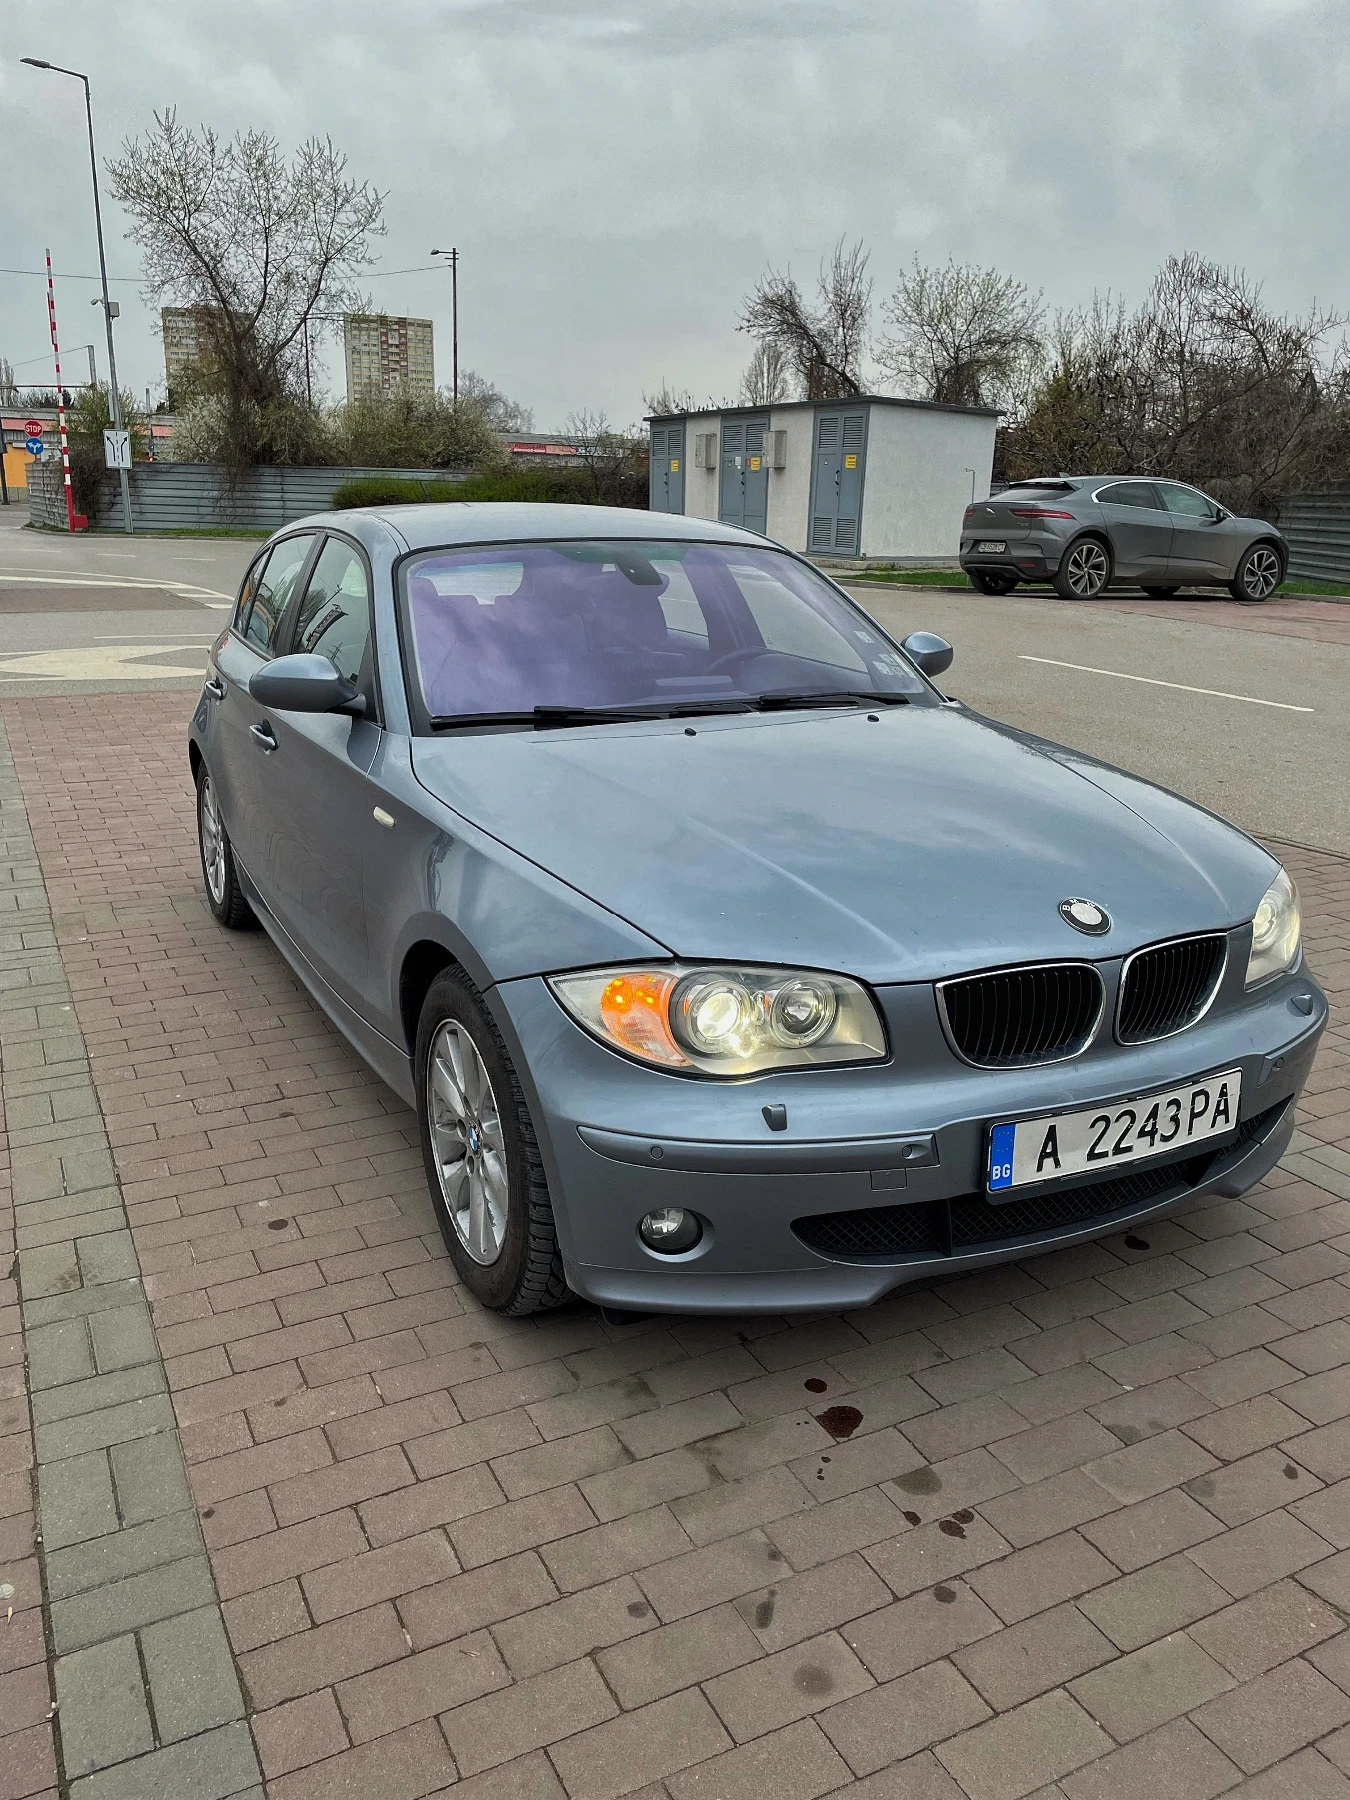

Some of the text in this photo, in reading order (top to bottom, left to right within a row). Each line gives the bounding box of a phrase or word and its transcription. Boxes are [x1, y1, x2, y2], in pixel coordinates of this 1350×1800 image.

[25, 425, 41, 433] STOP
[1035, 1124, 1061, 1173] A
[992, 1163, 1011, 1180] BG
